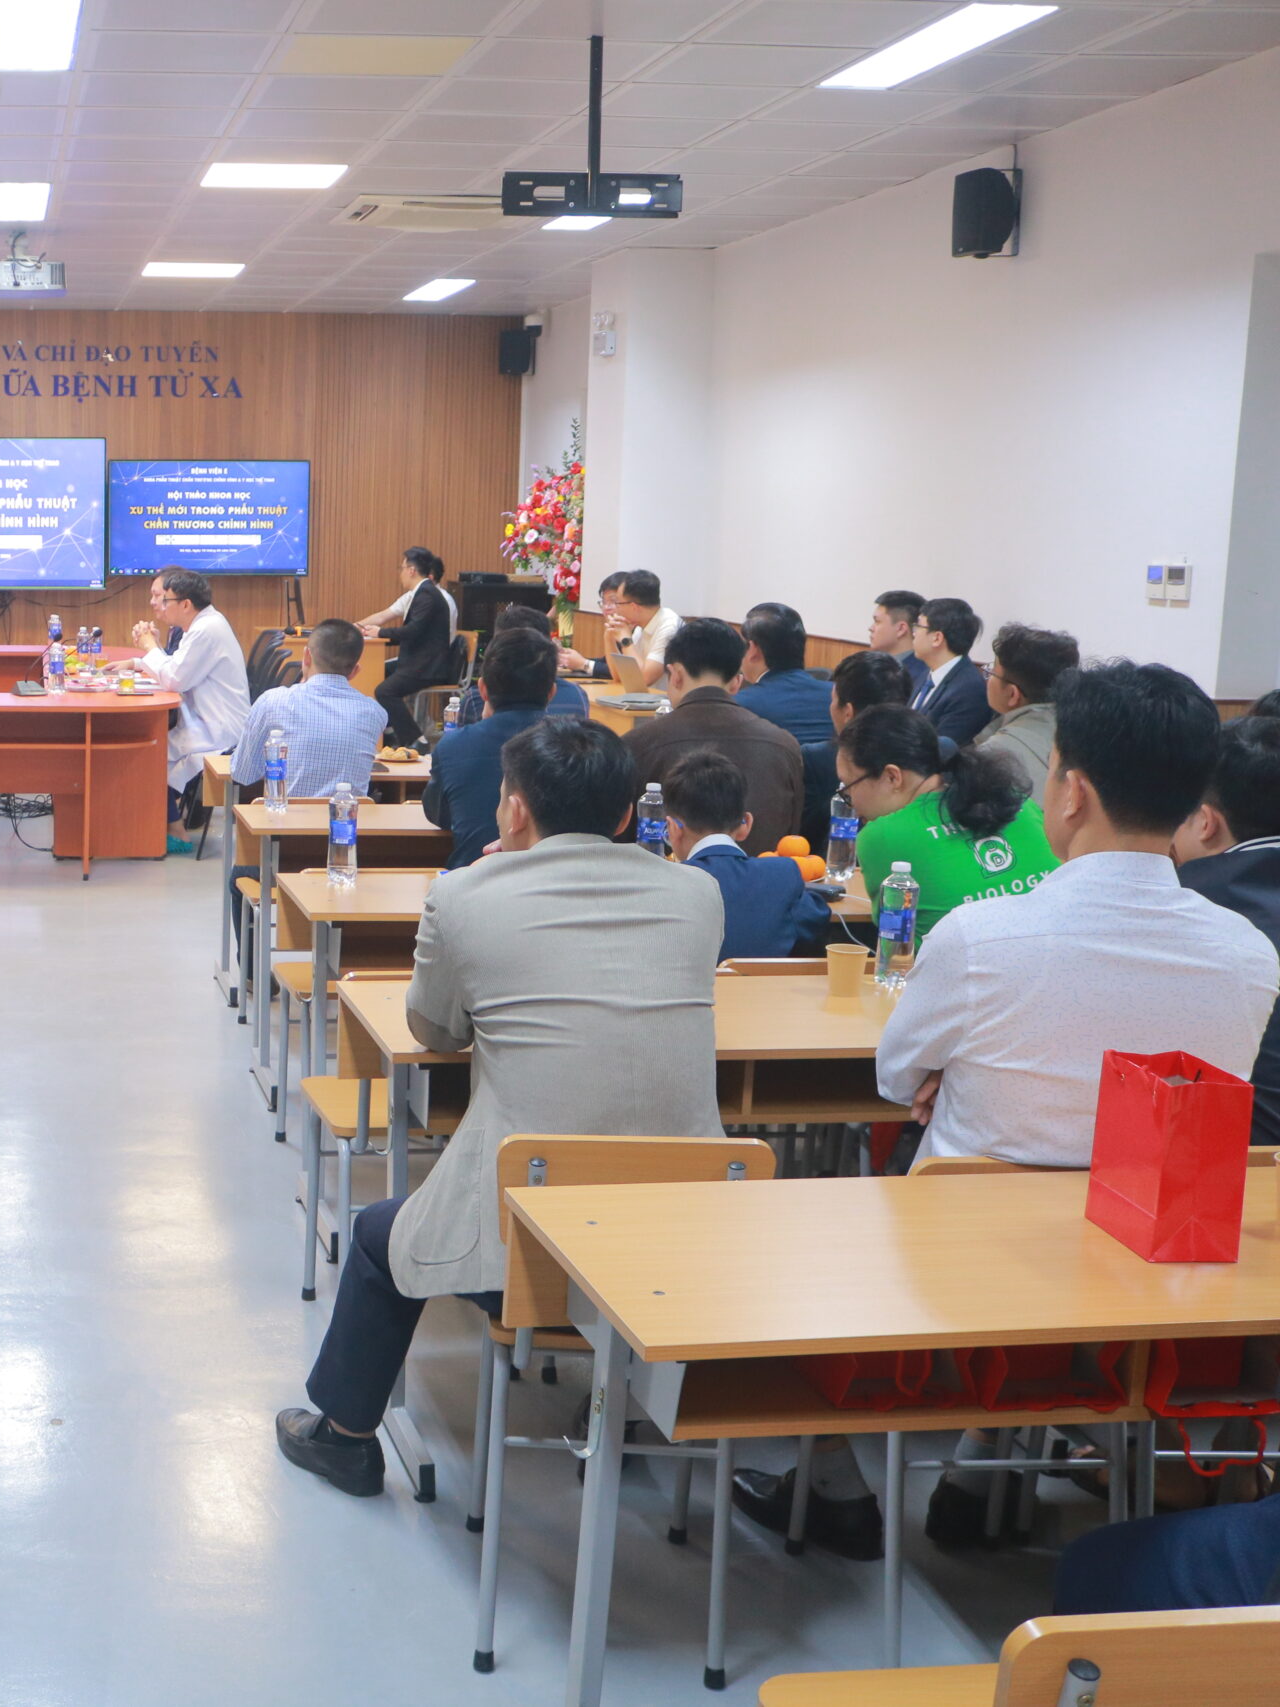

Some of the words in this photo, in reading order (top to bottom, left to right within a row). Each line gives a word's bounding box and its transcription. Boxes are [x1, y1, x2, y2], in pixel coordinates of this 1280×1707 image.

[85, 345, 131, 367] ĐẠO
[52, 371, 138, 403] BỆNH
[148, 368, 194, 398] TỪ
[199, 375, 243, 399] XA
[5, 478, 28, 491] HỌC
[168, 490, 183, 501] HỘI
[184, 490, 206, 499] THẢO
[234, 492, 251, 501] HỌC
[36, 495, 78, 512] THUẬT
[130, 506, 144, 515] XU
[146, 502, 164, 515] THẾ
[168, 504, 188, 515] MỚI
[190, 506, 225, 515] TRONG
[228, 502, 254, 515] PHẪU
[257, 504, 288, 517] THUẬT
[28, 513, 58, 528] HÌNH
[144, 517, 170, 529] CHẤN
[172, 520, 214, 529] THƯƠNG
[218, 518, 247, 529] CHỈNH
[250, 518, 274, 529] HÌNH
